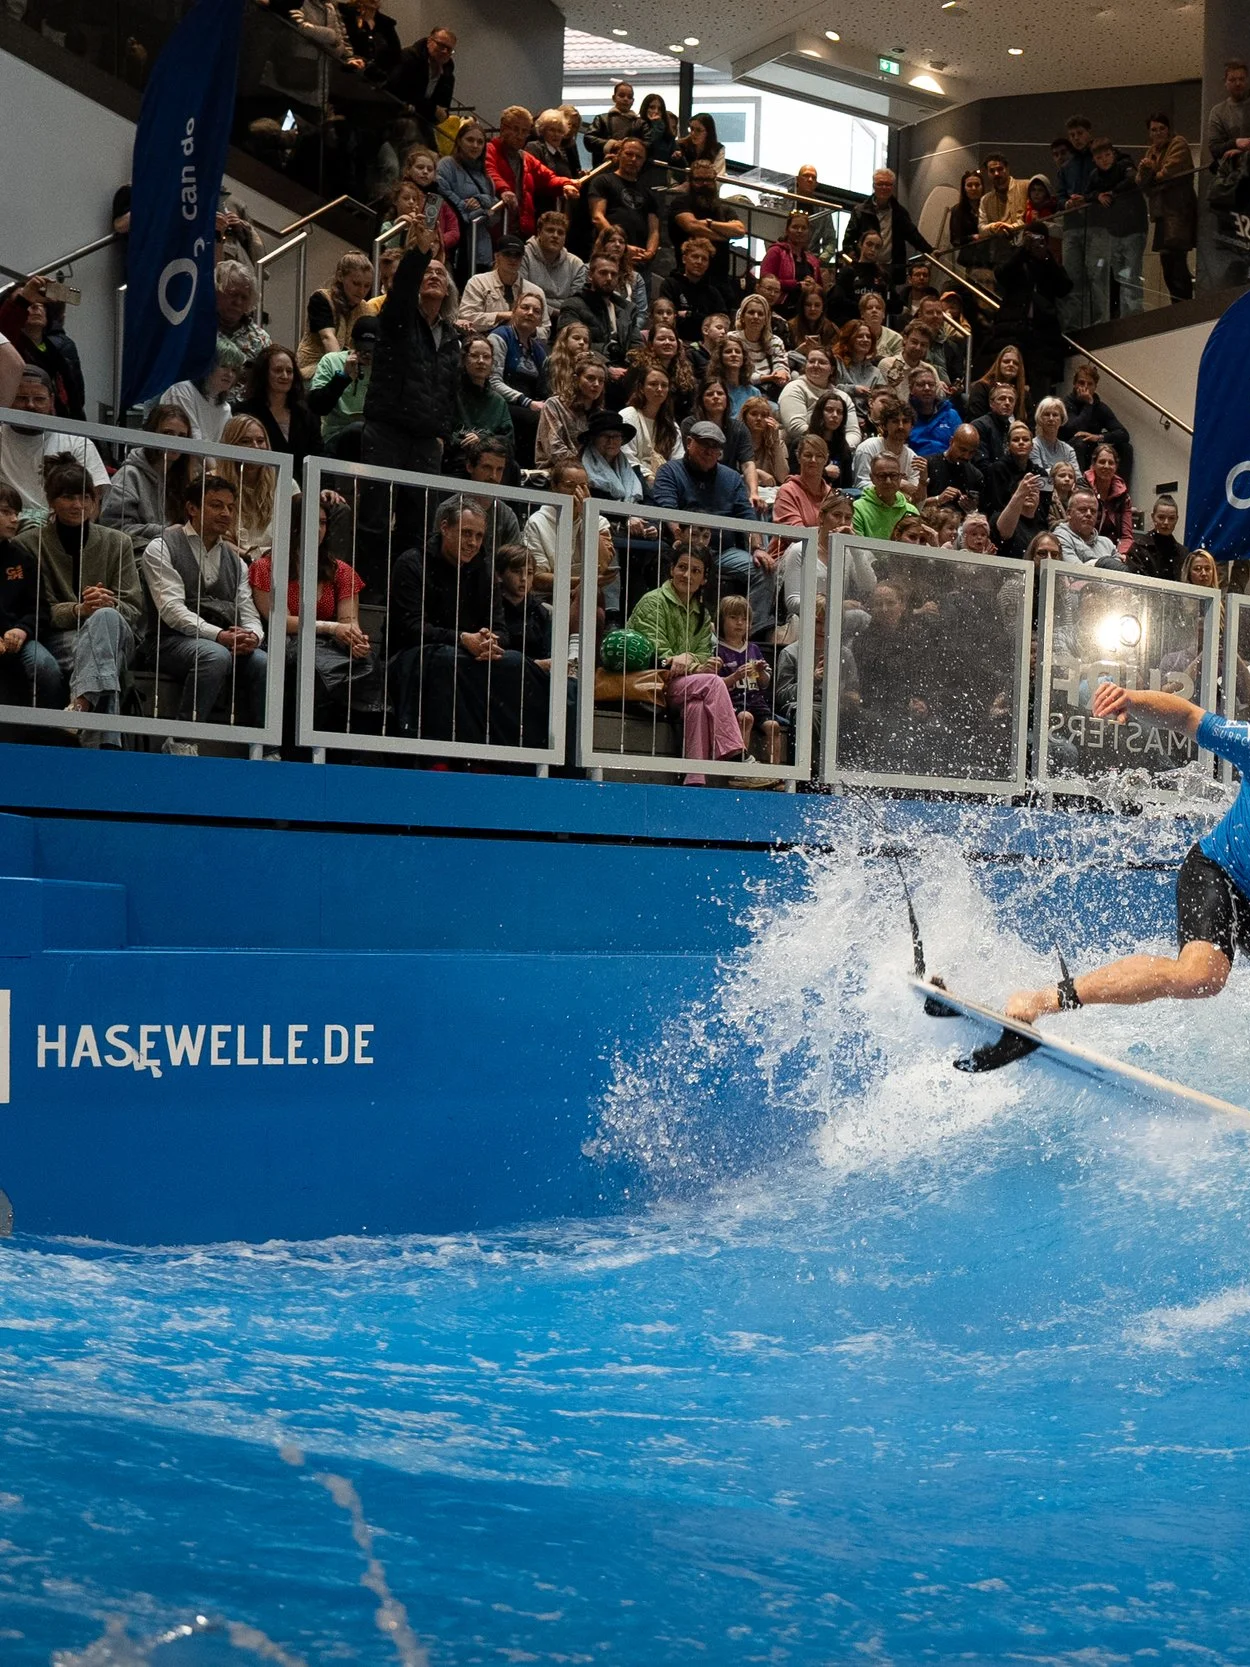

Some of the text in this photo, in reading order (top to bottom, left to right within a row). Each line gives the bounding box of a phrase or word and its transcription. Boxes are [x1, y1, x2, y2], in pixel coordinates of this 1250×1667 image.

[181, 117, 195, 156] do
[181, 165, 198, 221] can
[37, 1024, 374, 1070] HASEWELLE.DE
